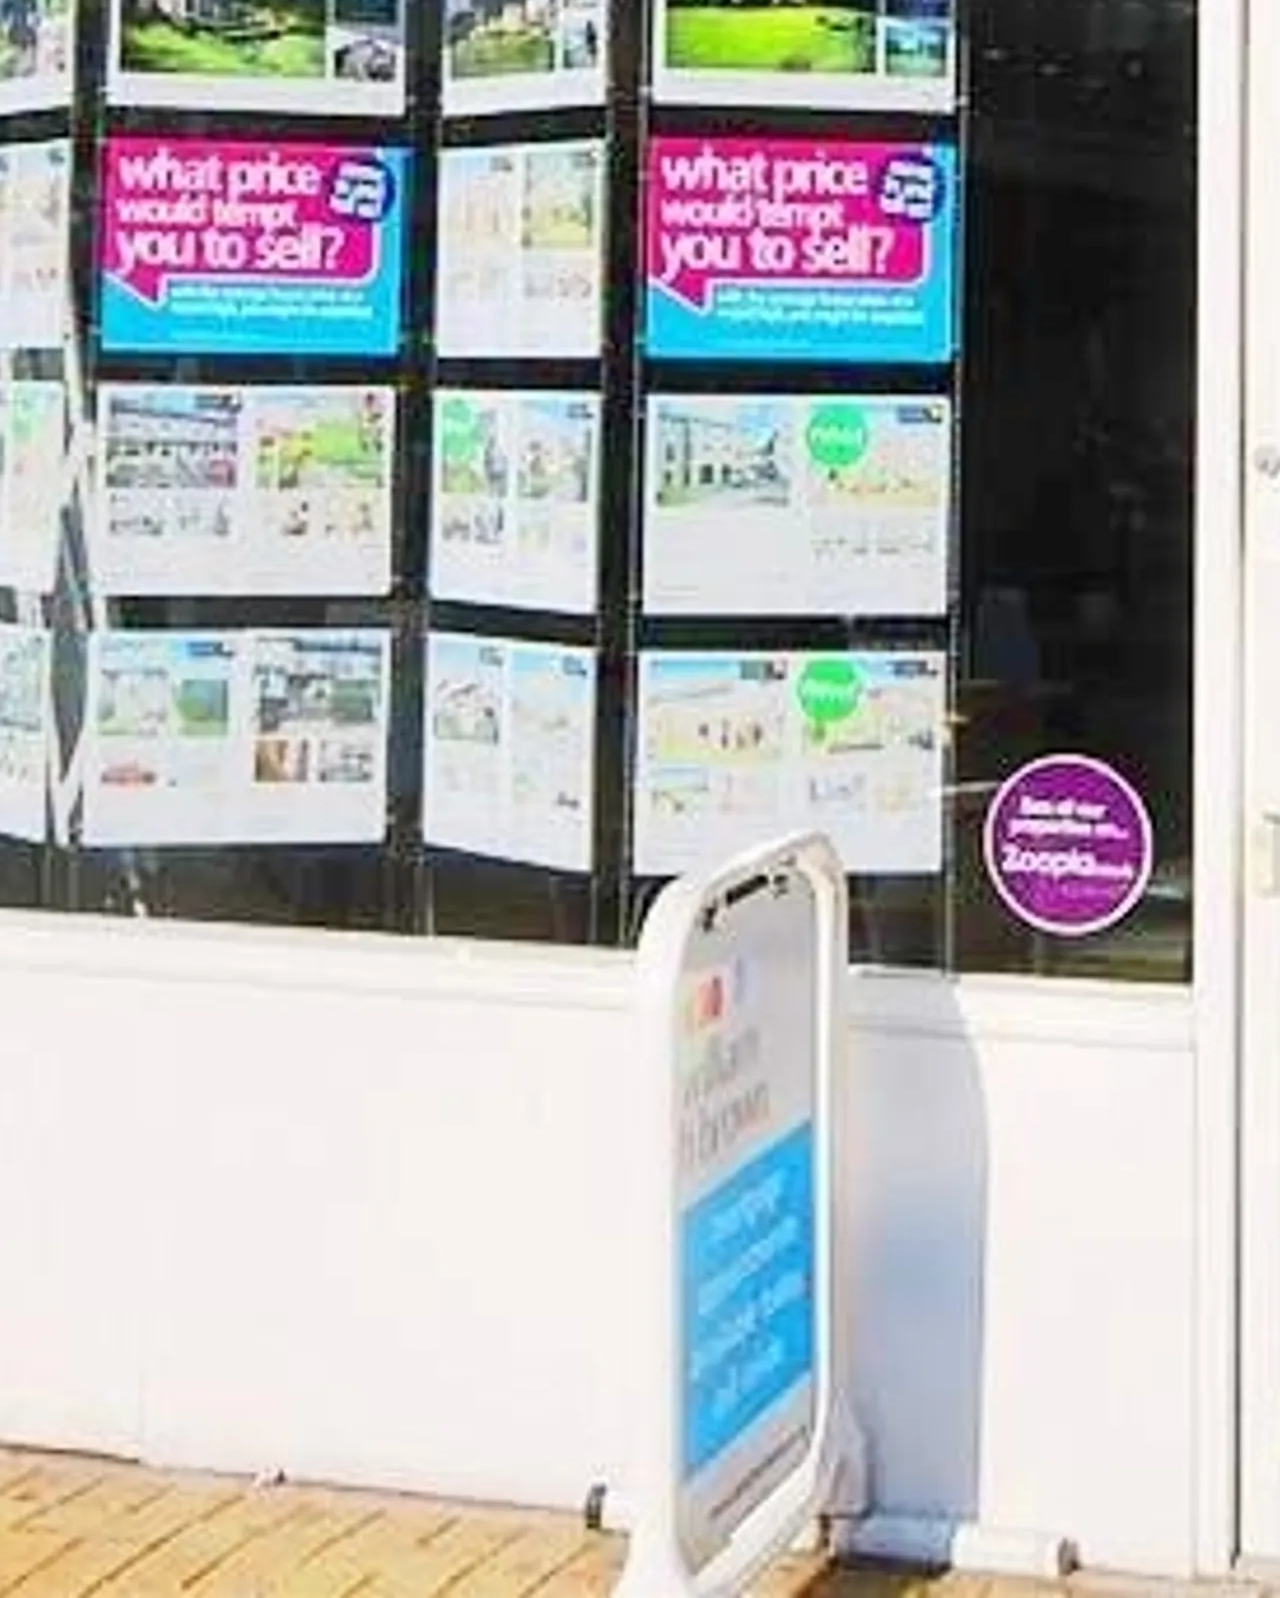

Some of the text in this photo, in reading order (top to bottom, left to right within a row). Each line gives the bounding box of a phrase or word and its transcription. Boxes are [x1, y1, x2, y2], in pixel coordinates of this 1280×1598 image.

[119, 147, 222, 191] what
[227, 152, 320, 200] price
[661, 146, 768, 191] what
[773, 151, 869, 202] price
[116, 195, 207, 224] would
[660, 196, 752, 227] would
[116, 223, 346, 275] you to sell?
[660, 225, 896, 282] you to sell?
